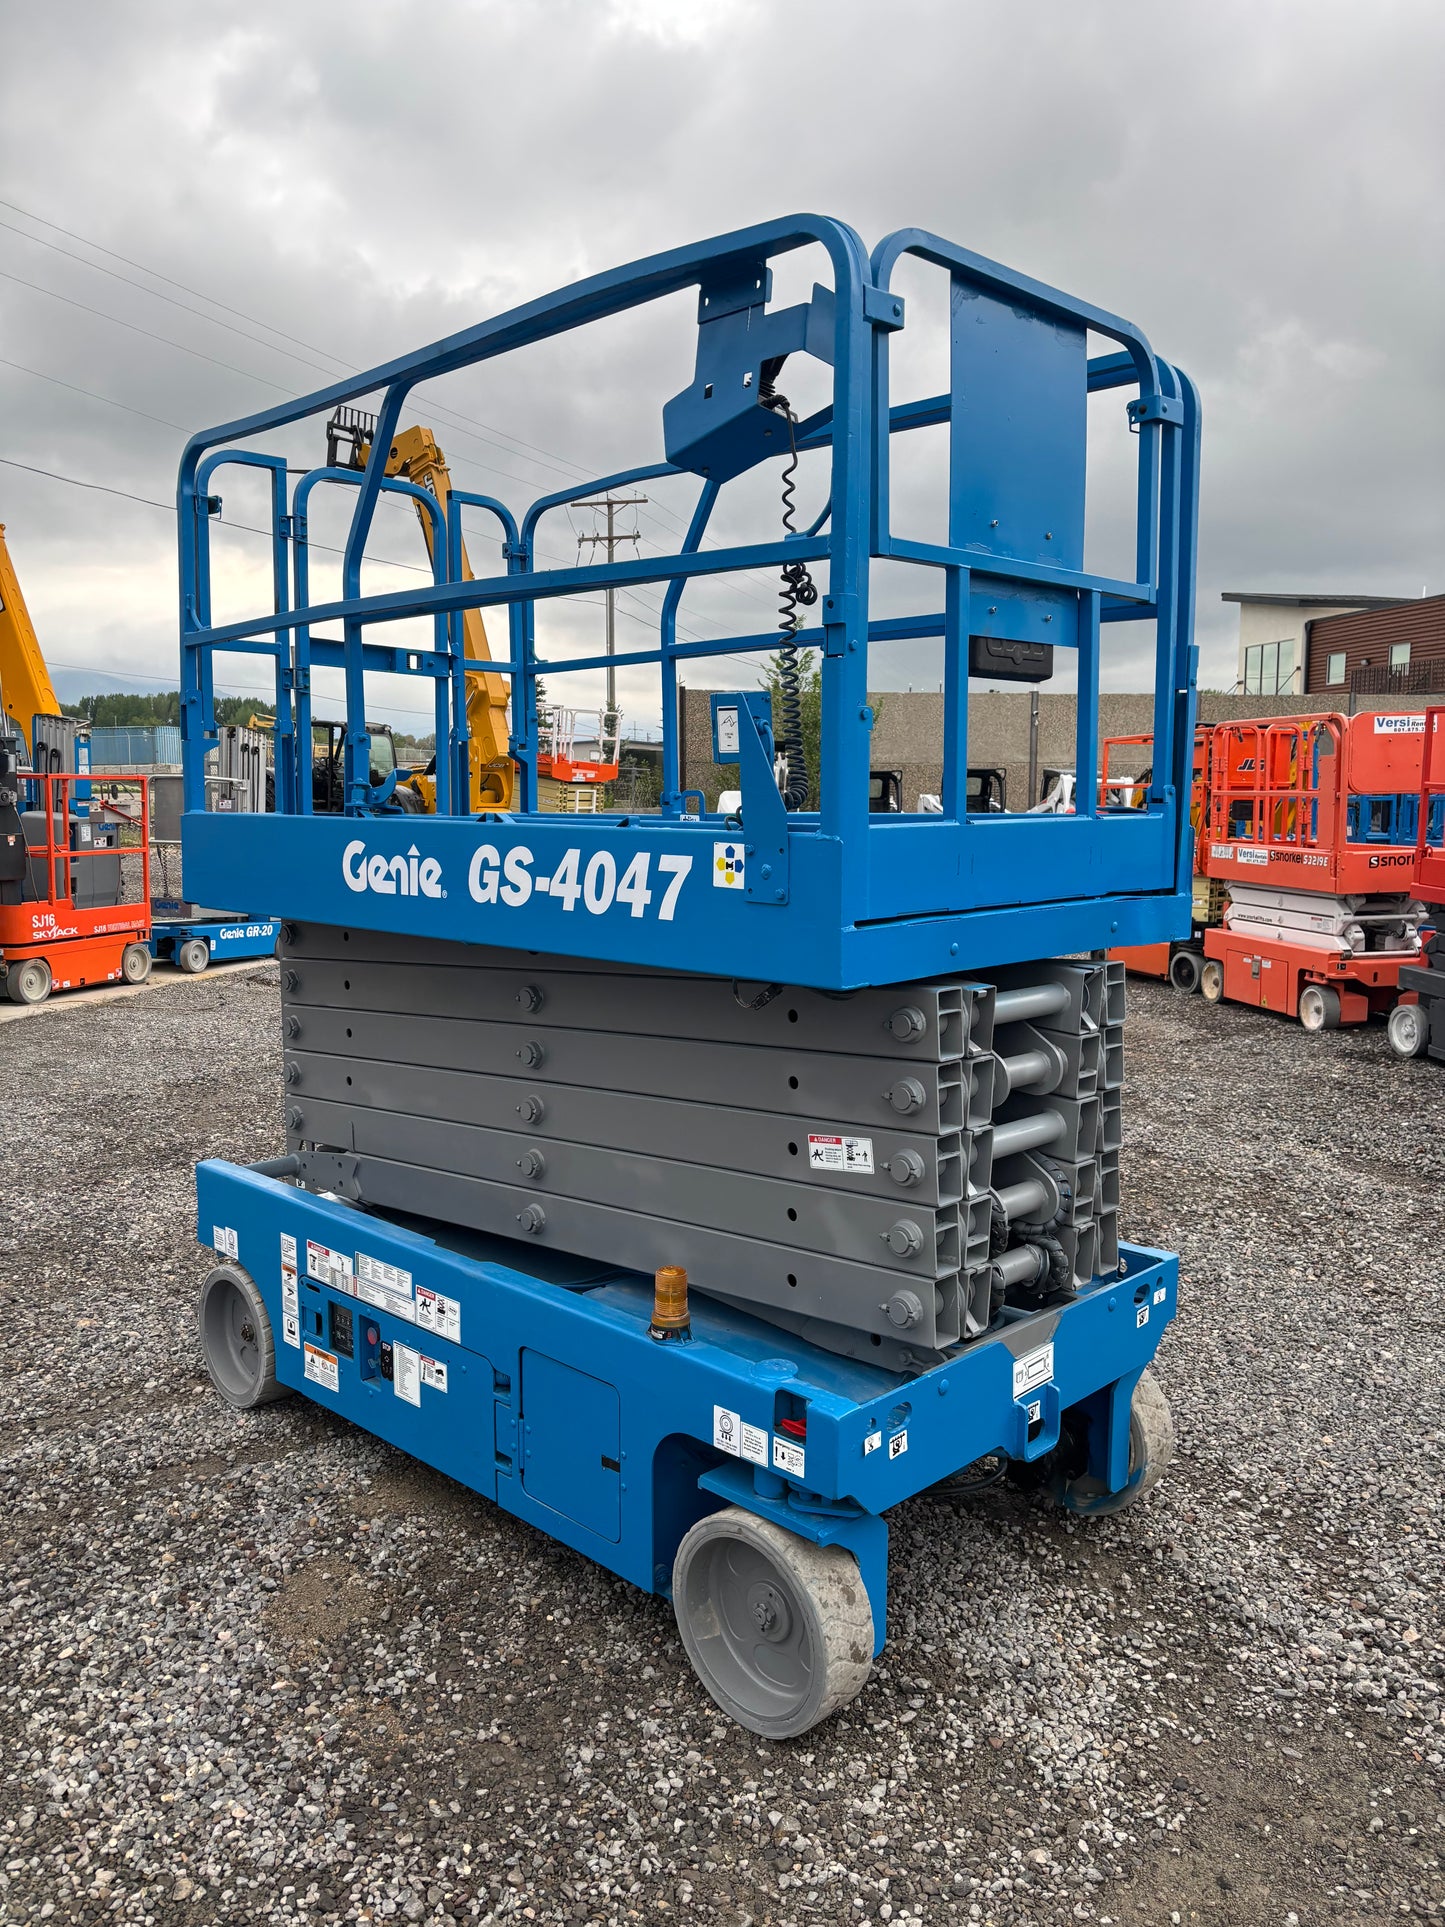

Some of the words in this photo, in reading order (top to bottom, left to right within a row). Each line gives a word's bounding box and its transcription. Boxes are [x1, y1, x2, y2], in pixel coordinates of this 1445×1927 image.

[1376, 716, 1410, 728] Versi
[1238, 848, 1255, 858] Versi
[1303, 855, 1329, 867] S3219E
[342, 840, 443, 898] Genie
[468, 844, 693, 921] GS-4047
[32, 914, 56, 928] SJ16
[32, 925, 79, 940] SKYJACK
[93, 924, 107, 934] SJ16
[219, 928, 245, 940] Genie
[246, 925, 273, 938] GR-20
